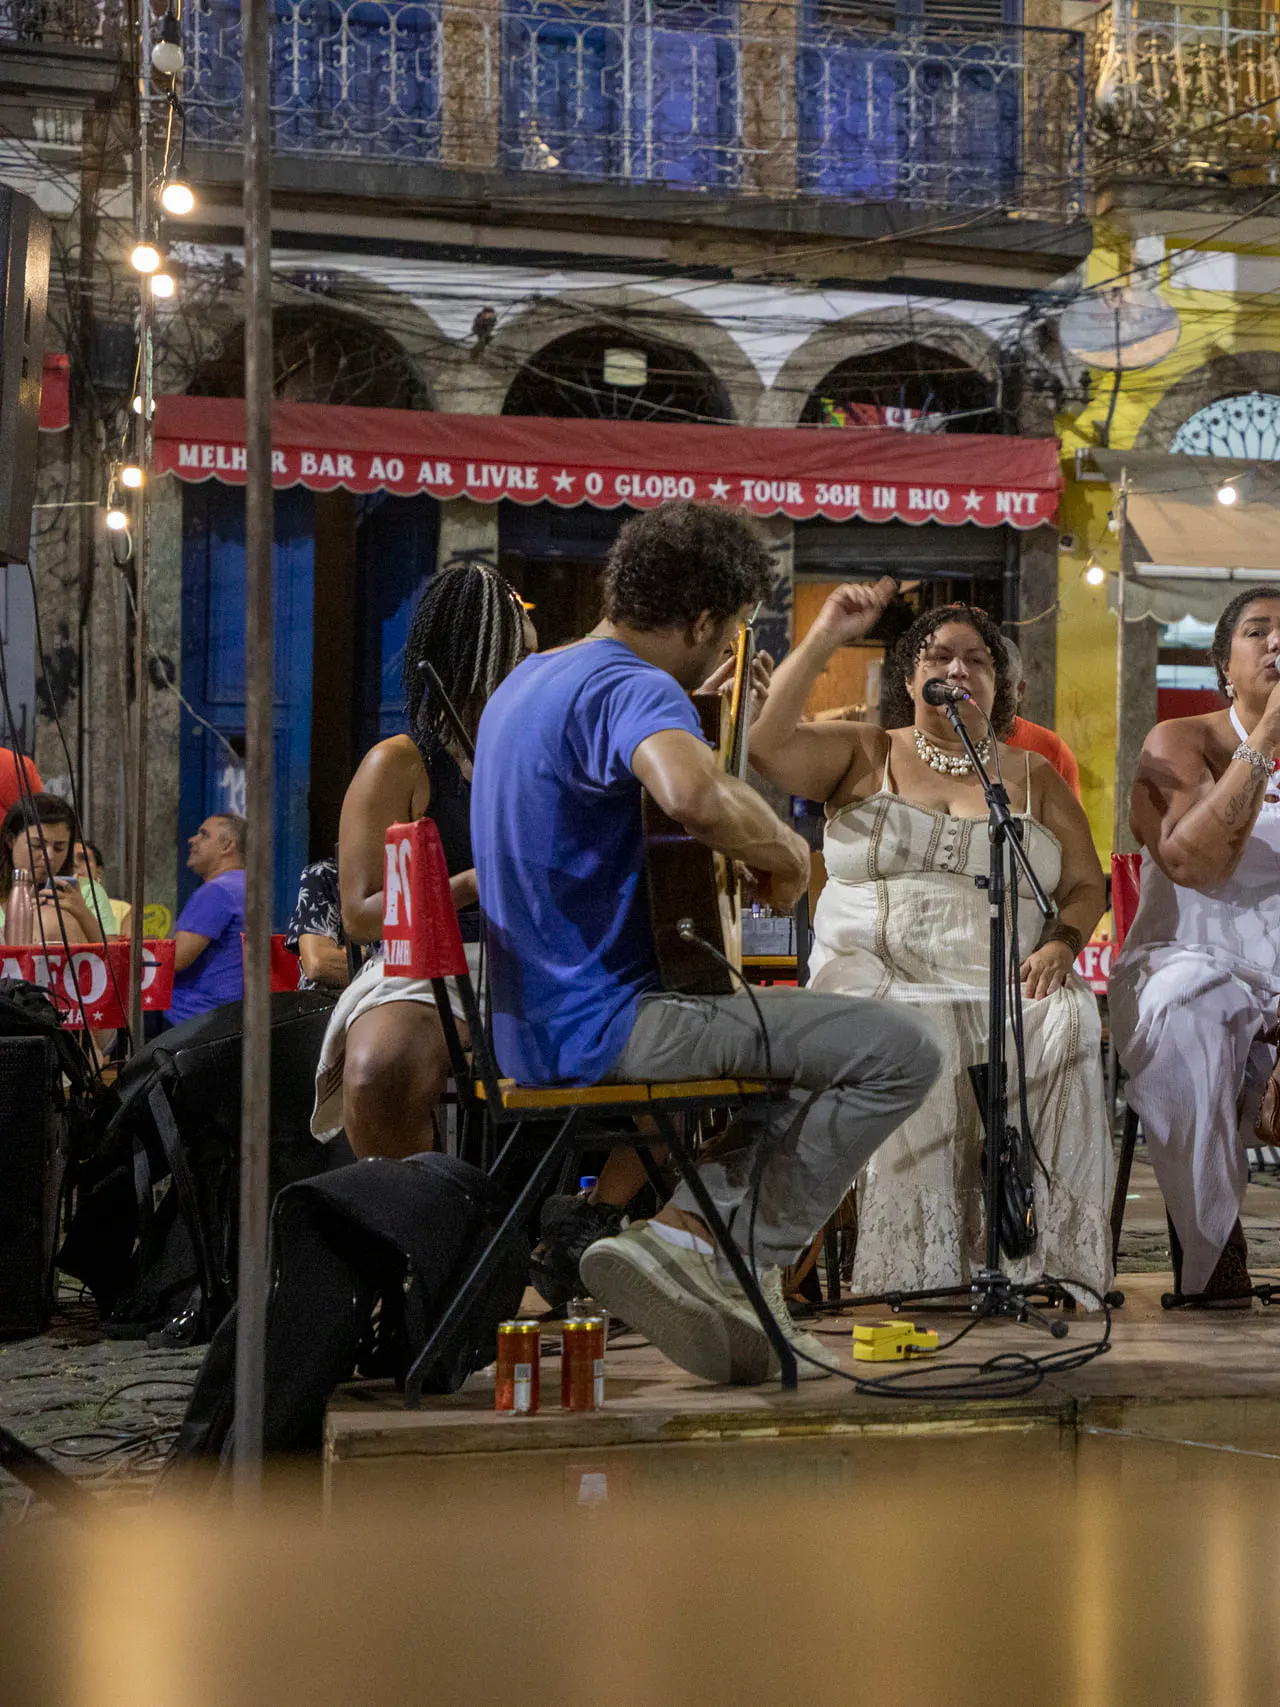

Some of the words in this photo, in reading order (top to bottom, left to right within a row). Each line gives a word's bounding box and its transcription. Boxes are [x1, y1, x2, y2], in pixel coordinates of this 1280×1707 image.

[178, 443, 288, 474] MELHR
[300, 452, 356, 479] BAR
[368, 456, 405, 481] AO
[416, 461, 454, 487] AR
[465, 463, 540, 490] LIVRE
[584, 471, 604, 496] O
[613, 473, 697, 500] GLOBO
[739, 478, 806, 505] TOUR
[871, 485, 898, 510] IN
[907, 487, 951, 512] RIO
[995, 491, 1040, 515] NYT
